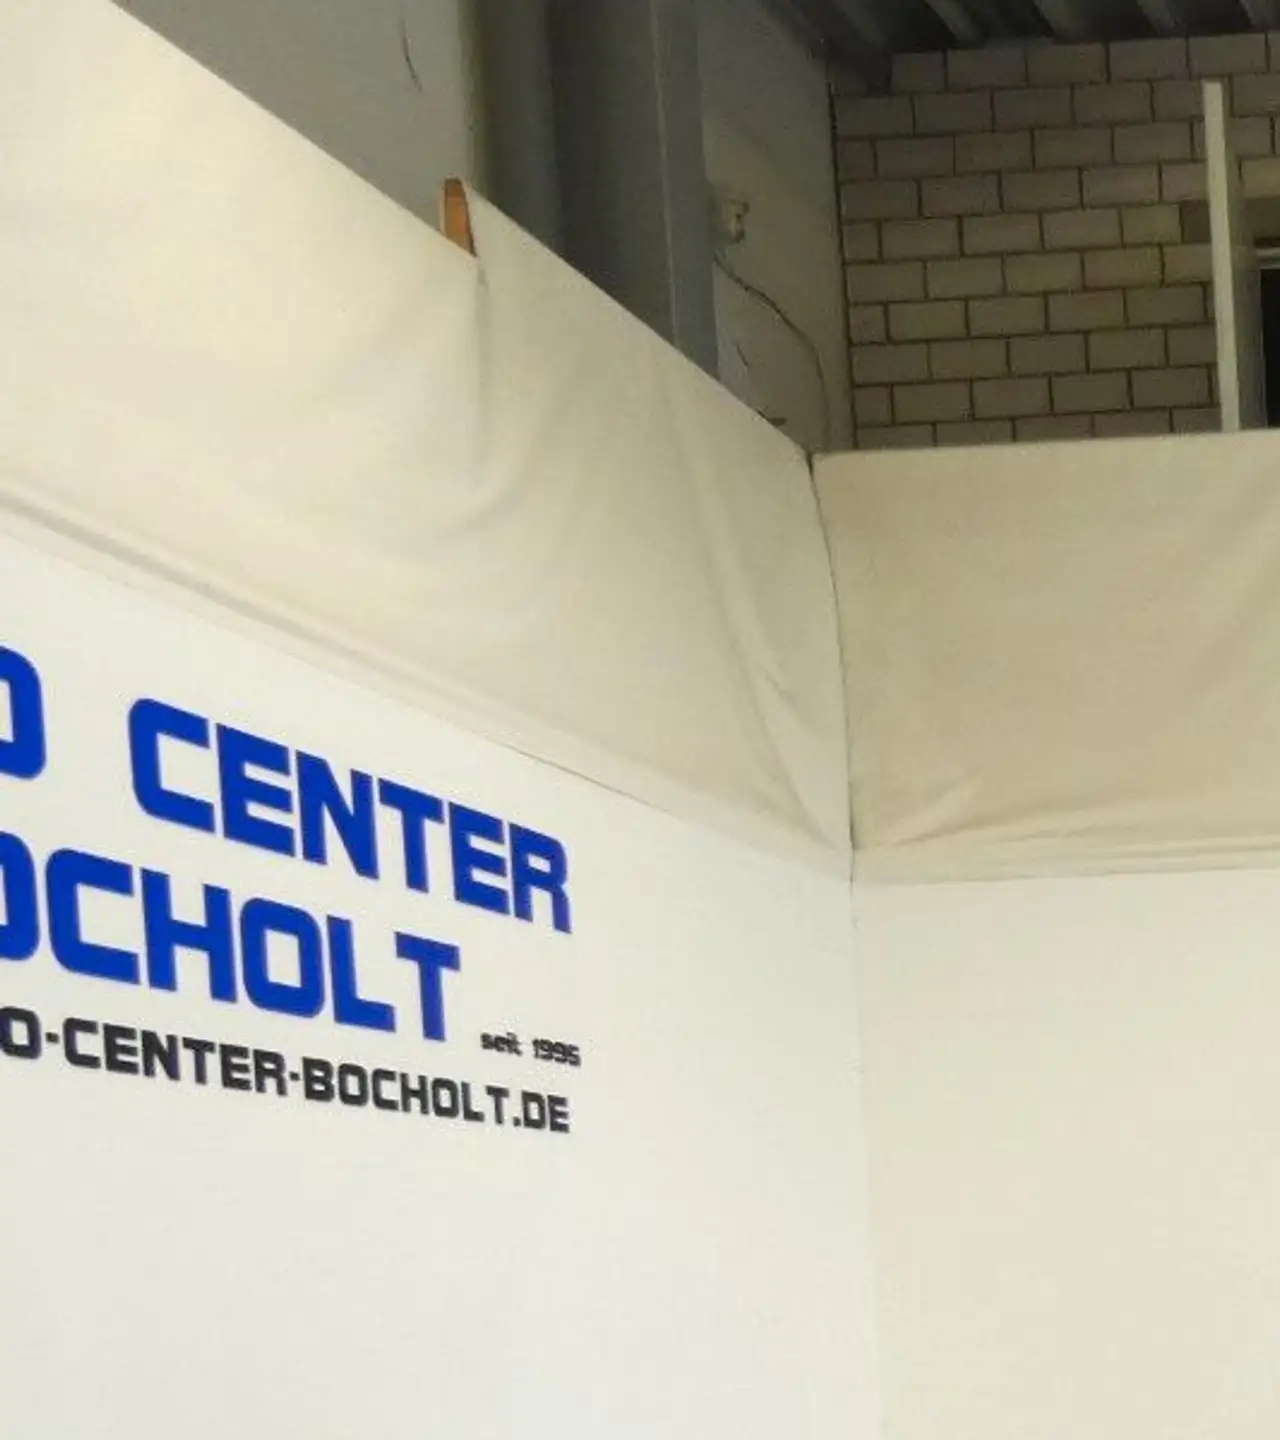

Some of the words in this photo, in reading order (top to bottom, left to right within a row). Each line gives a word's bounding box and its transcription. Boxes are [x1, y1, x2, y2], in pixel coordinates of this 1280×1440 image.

[128, 698, 571, 932] CENTER
[480, 1031, 521, 1056] seit
[532, 1037, 581, 1067] 1995
